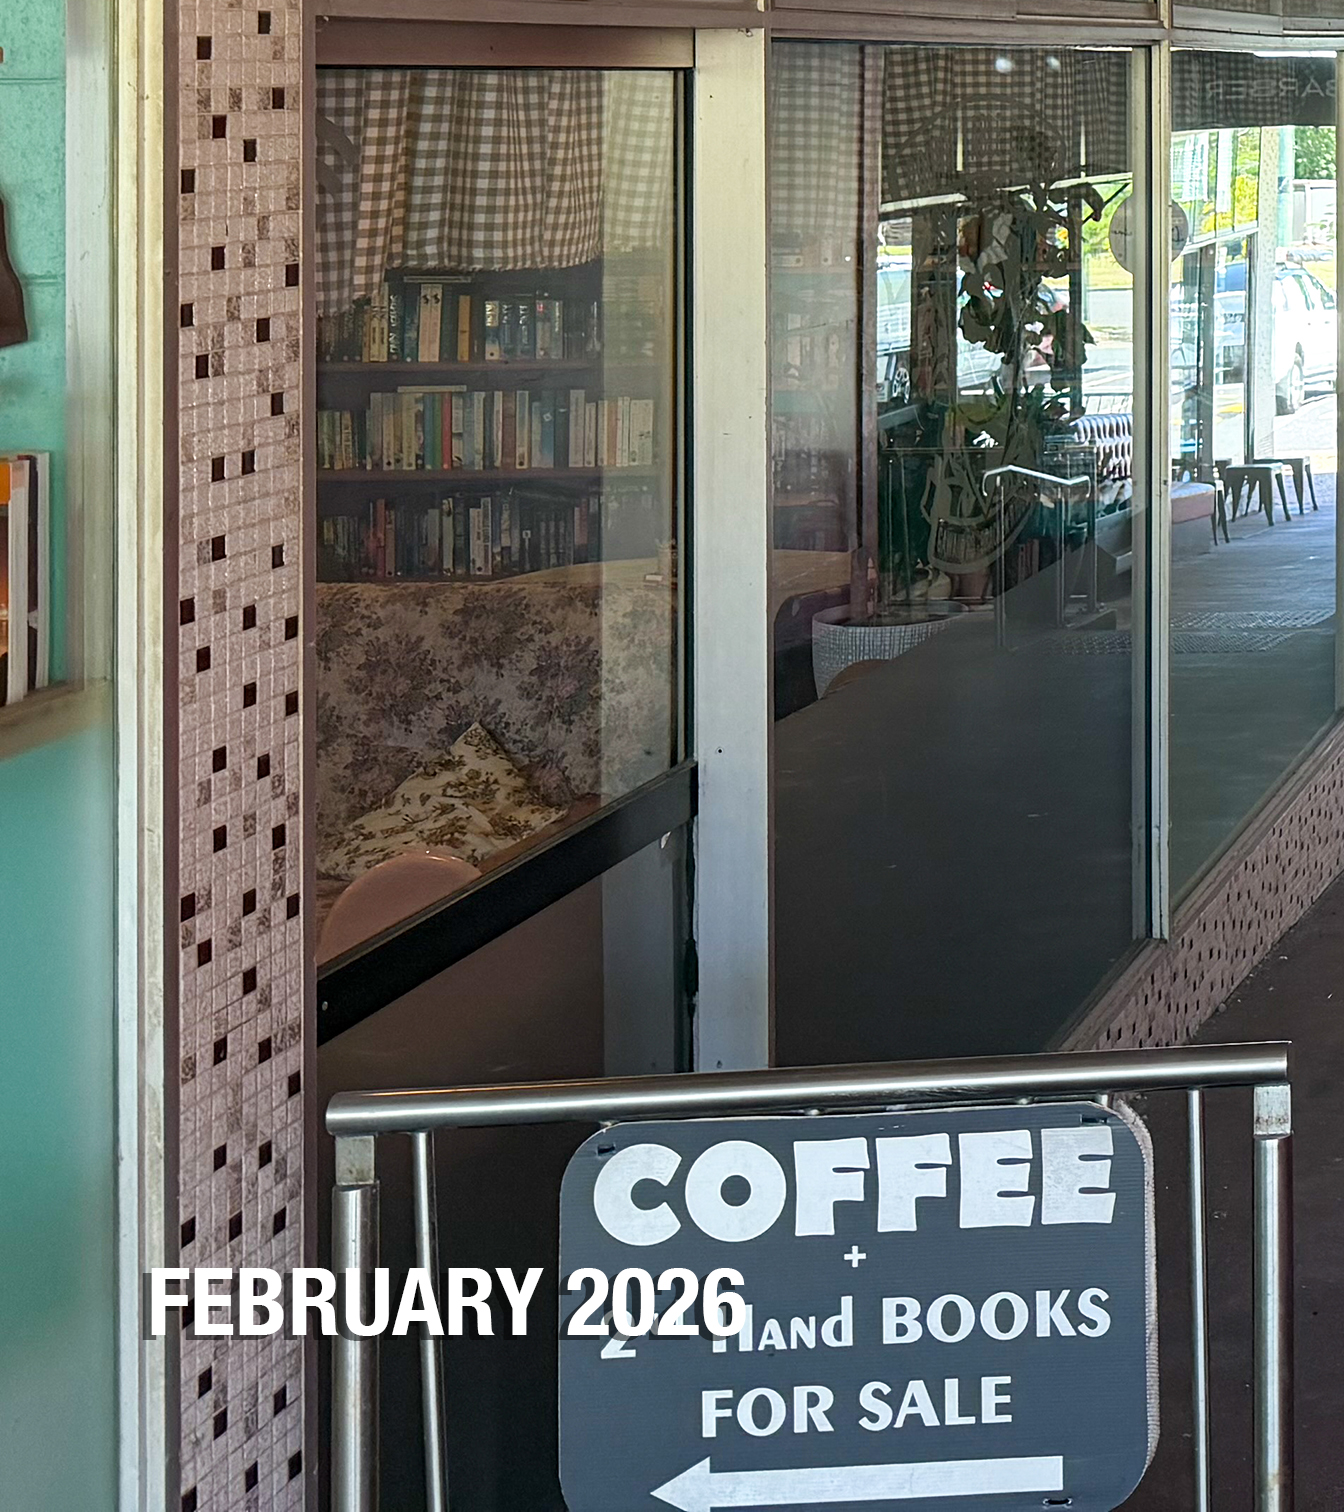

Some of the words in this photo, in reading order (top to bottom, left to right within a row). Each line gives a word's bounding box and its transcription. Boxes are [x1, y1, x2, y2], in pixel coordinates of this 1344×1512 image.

[593, 1124, 1117, 1246] COFFEE
[881, 1288, 1111, 1346] BOOKS
[700, 1380, 833, 1439] FOR
[858, 1374, 1012, 1430] SALE
